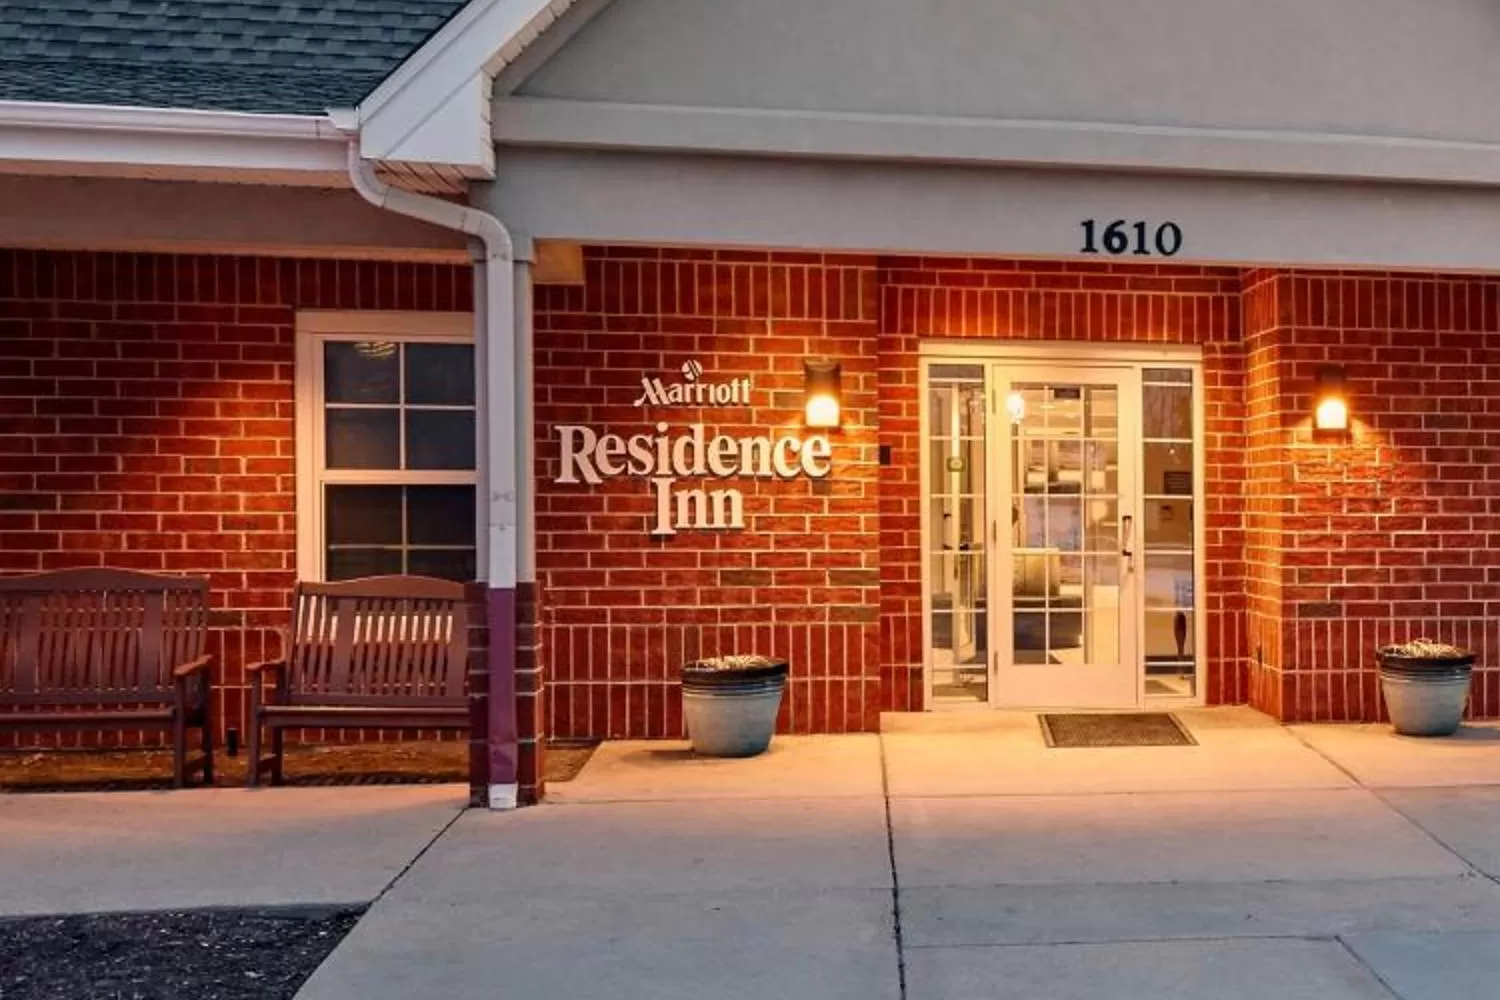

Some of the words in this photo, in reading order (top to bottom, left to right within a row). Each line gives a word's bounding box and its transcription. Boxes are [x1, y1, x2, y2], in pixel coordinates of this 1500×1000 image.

[1080, 219, 1183, 257] 1610
[633, 376, 753, 407] Marriott
[554, 421, 832, 484] Residence
[651, 477, 745, 535] Inn
